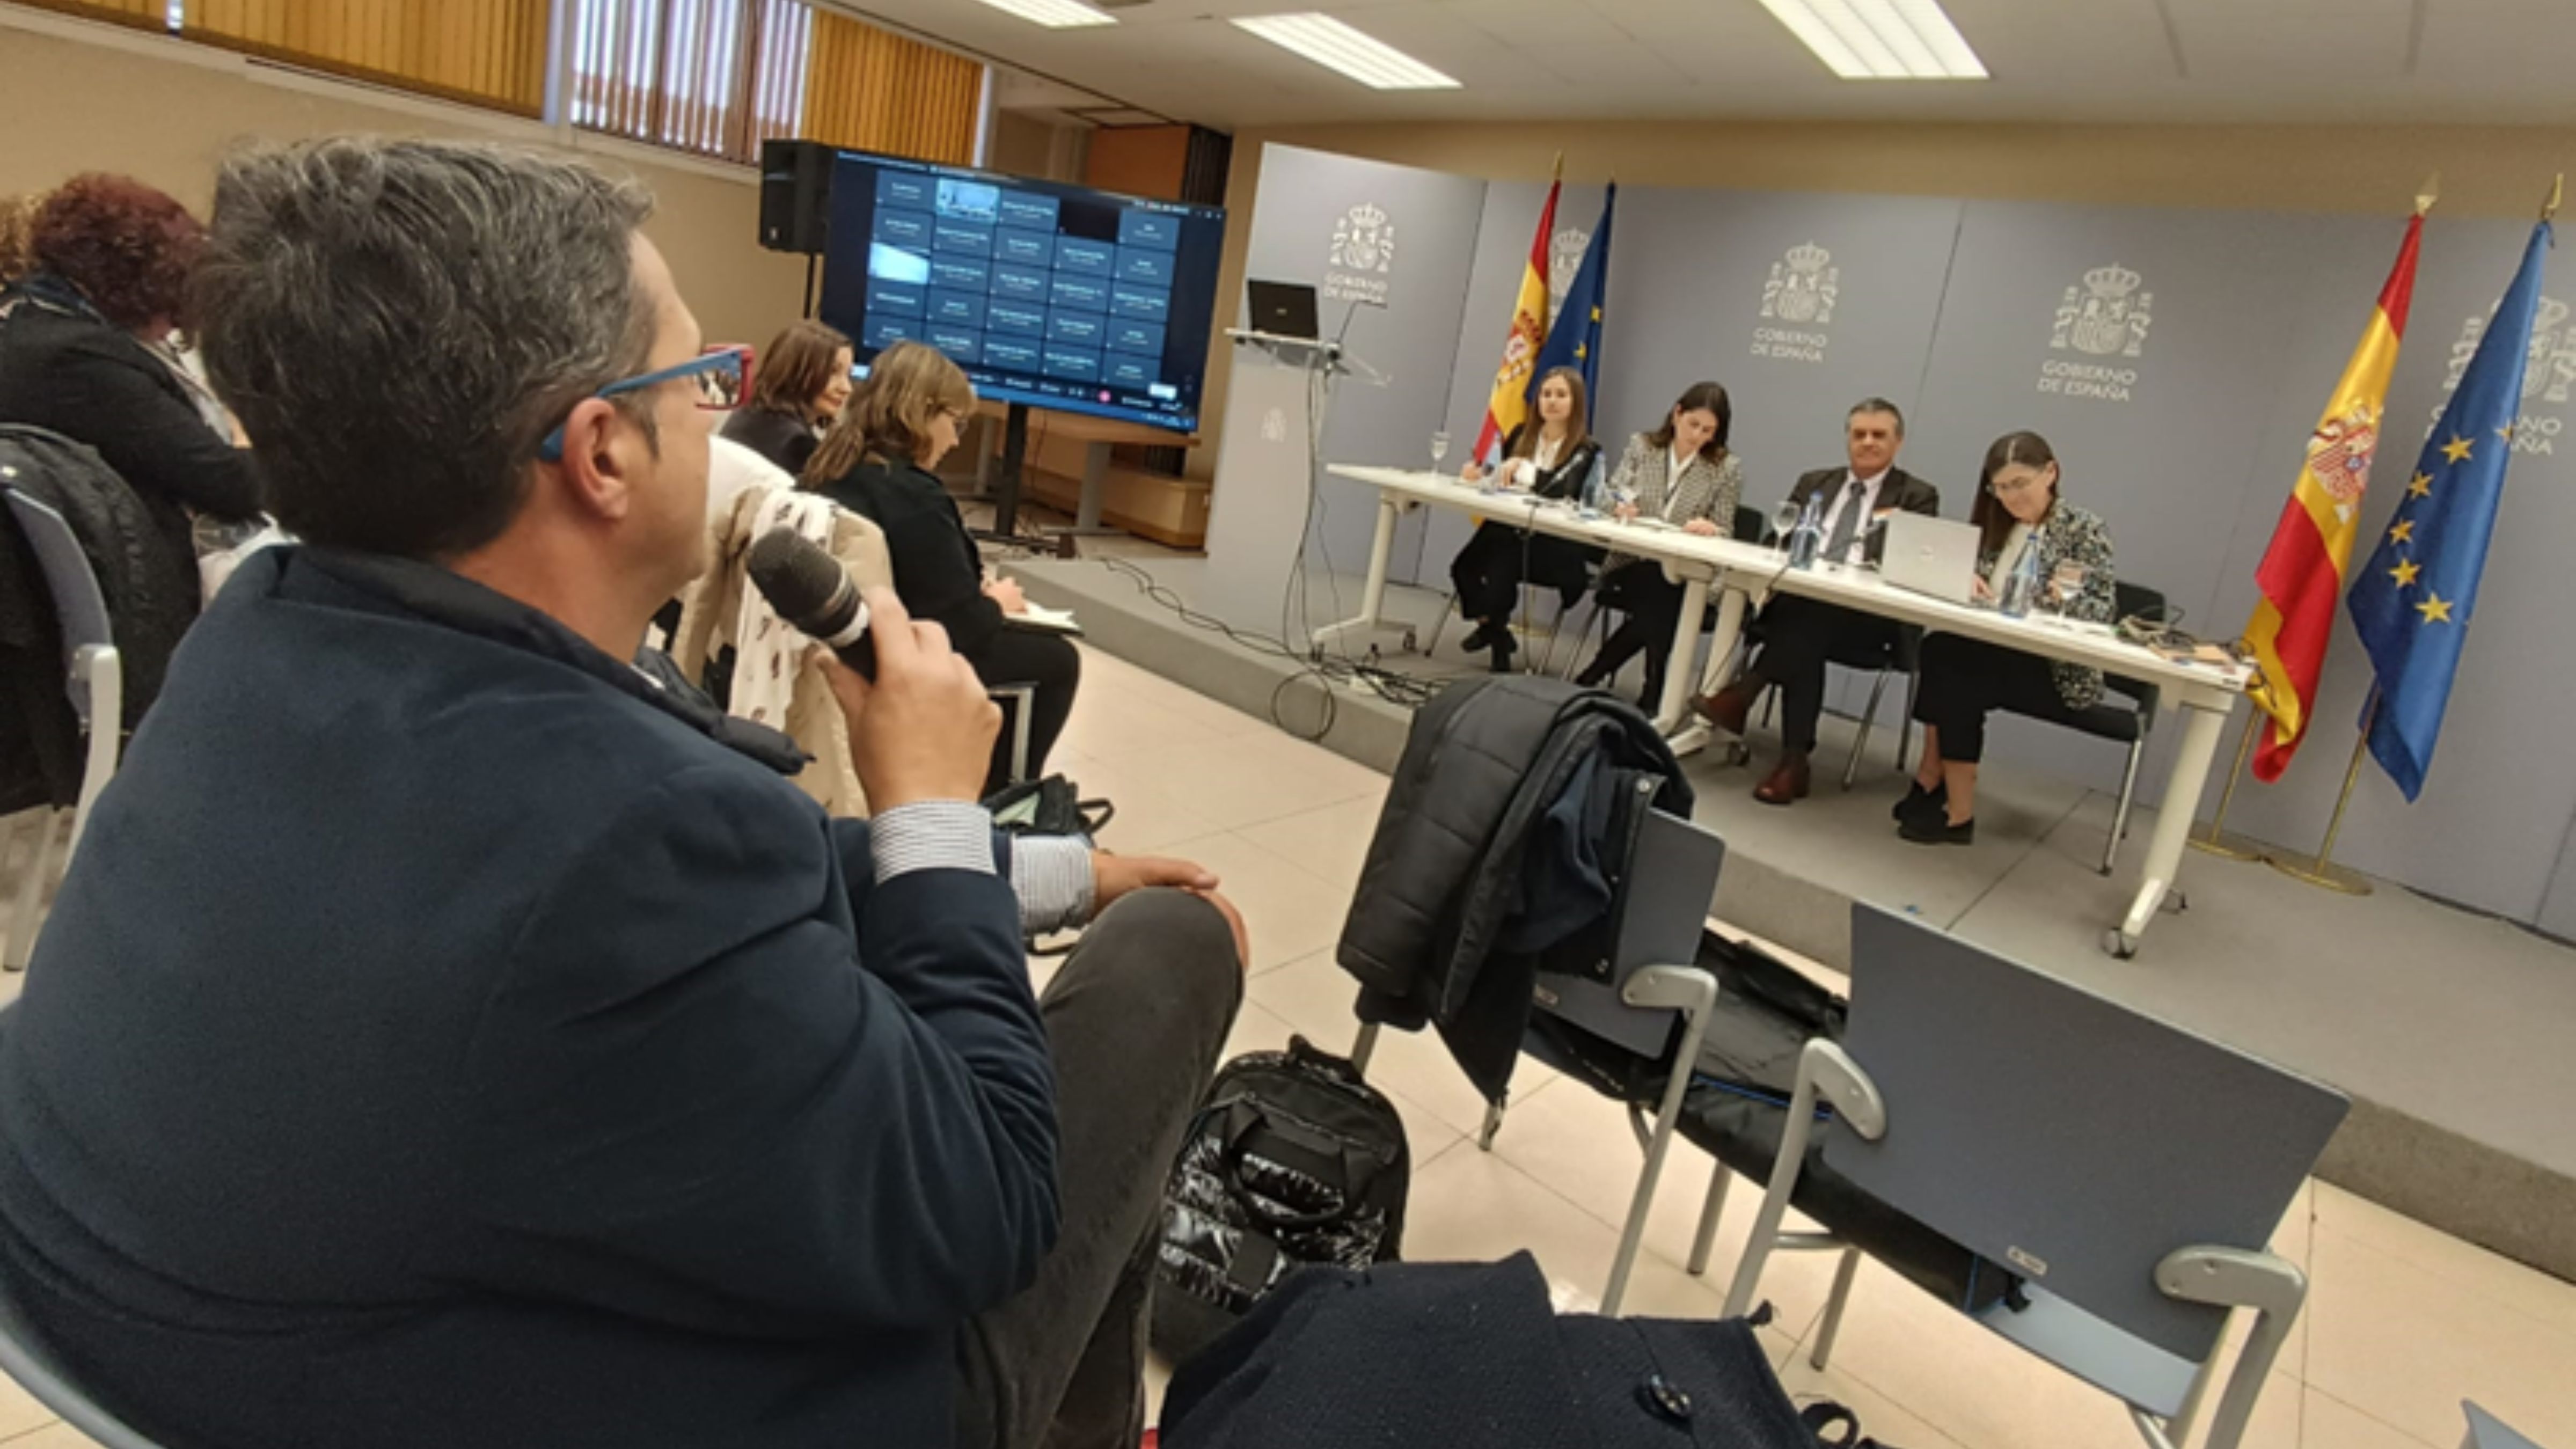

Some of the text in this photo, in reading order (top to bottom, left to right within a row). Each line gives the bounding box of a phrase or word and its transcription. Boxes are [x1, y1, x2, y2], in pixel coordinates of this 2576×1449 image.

[1753, 328, 1827, 347] GOBIERNO
[1750, 342, 1823, 363] DE ESPAÑA
[2042, 360, 2137, 385] GOBIERNO
[2038, 377, 2129, 402] DE ESPAÑA
